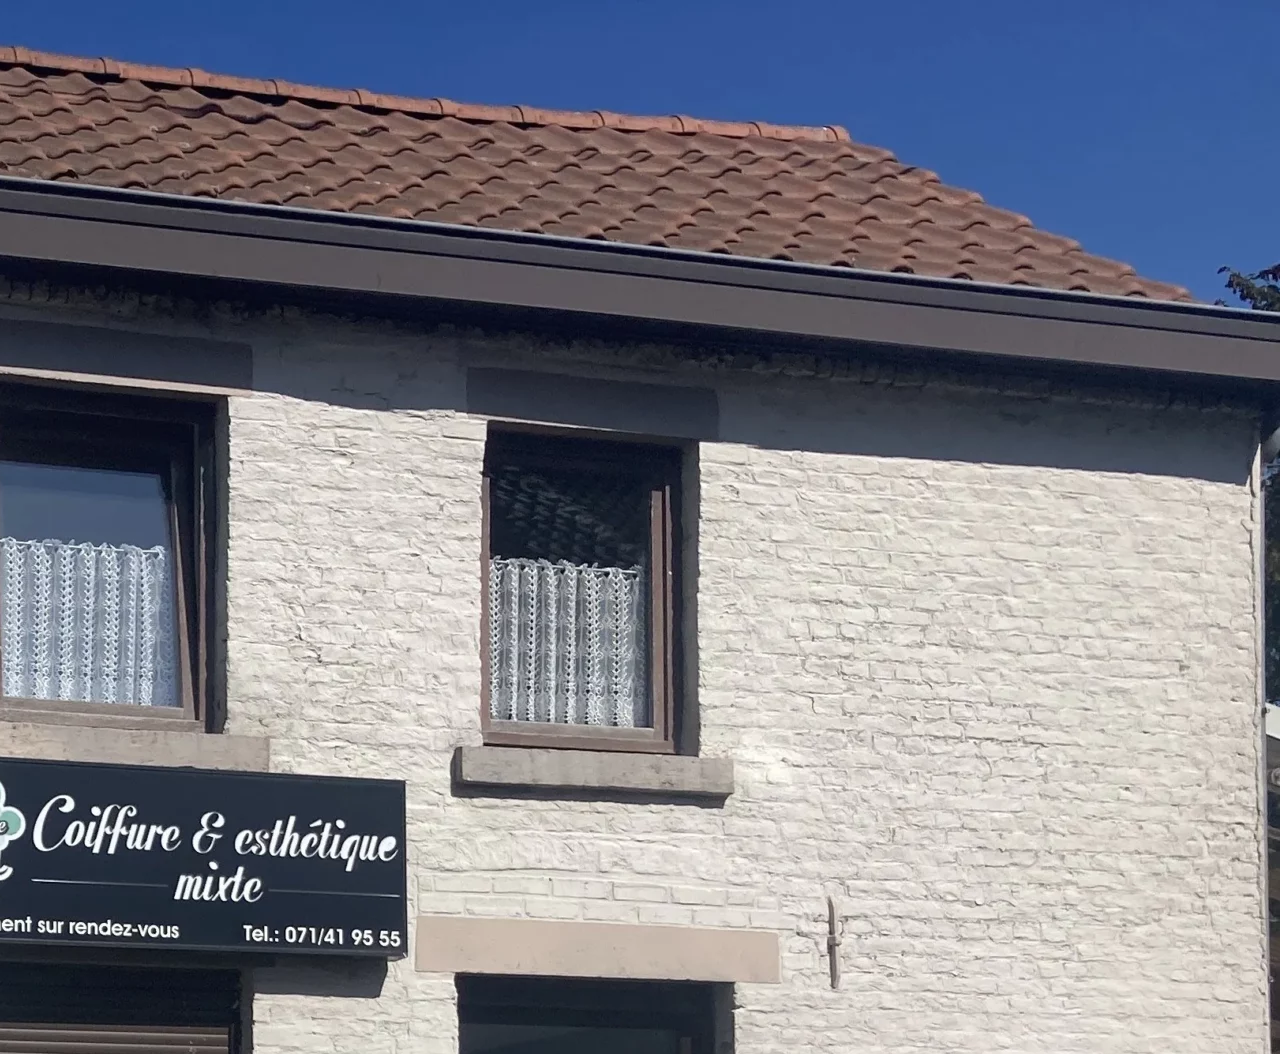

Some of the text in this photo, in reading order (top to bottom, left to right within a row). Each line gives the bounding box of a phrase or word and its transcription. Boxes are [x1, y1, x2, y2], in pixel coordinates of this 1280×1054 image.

[32, 794, 398, 872] Coiffure & esthétique
[173, 861, 263, 902] mixte
[37, 919, 64, 934] sur
[68, 919, 180, 939] rendez-vous
[243, 925, 401, 947] Tel.: 071/41 95 55
